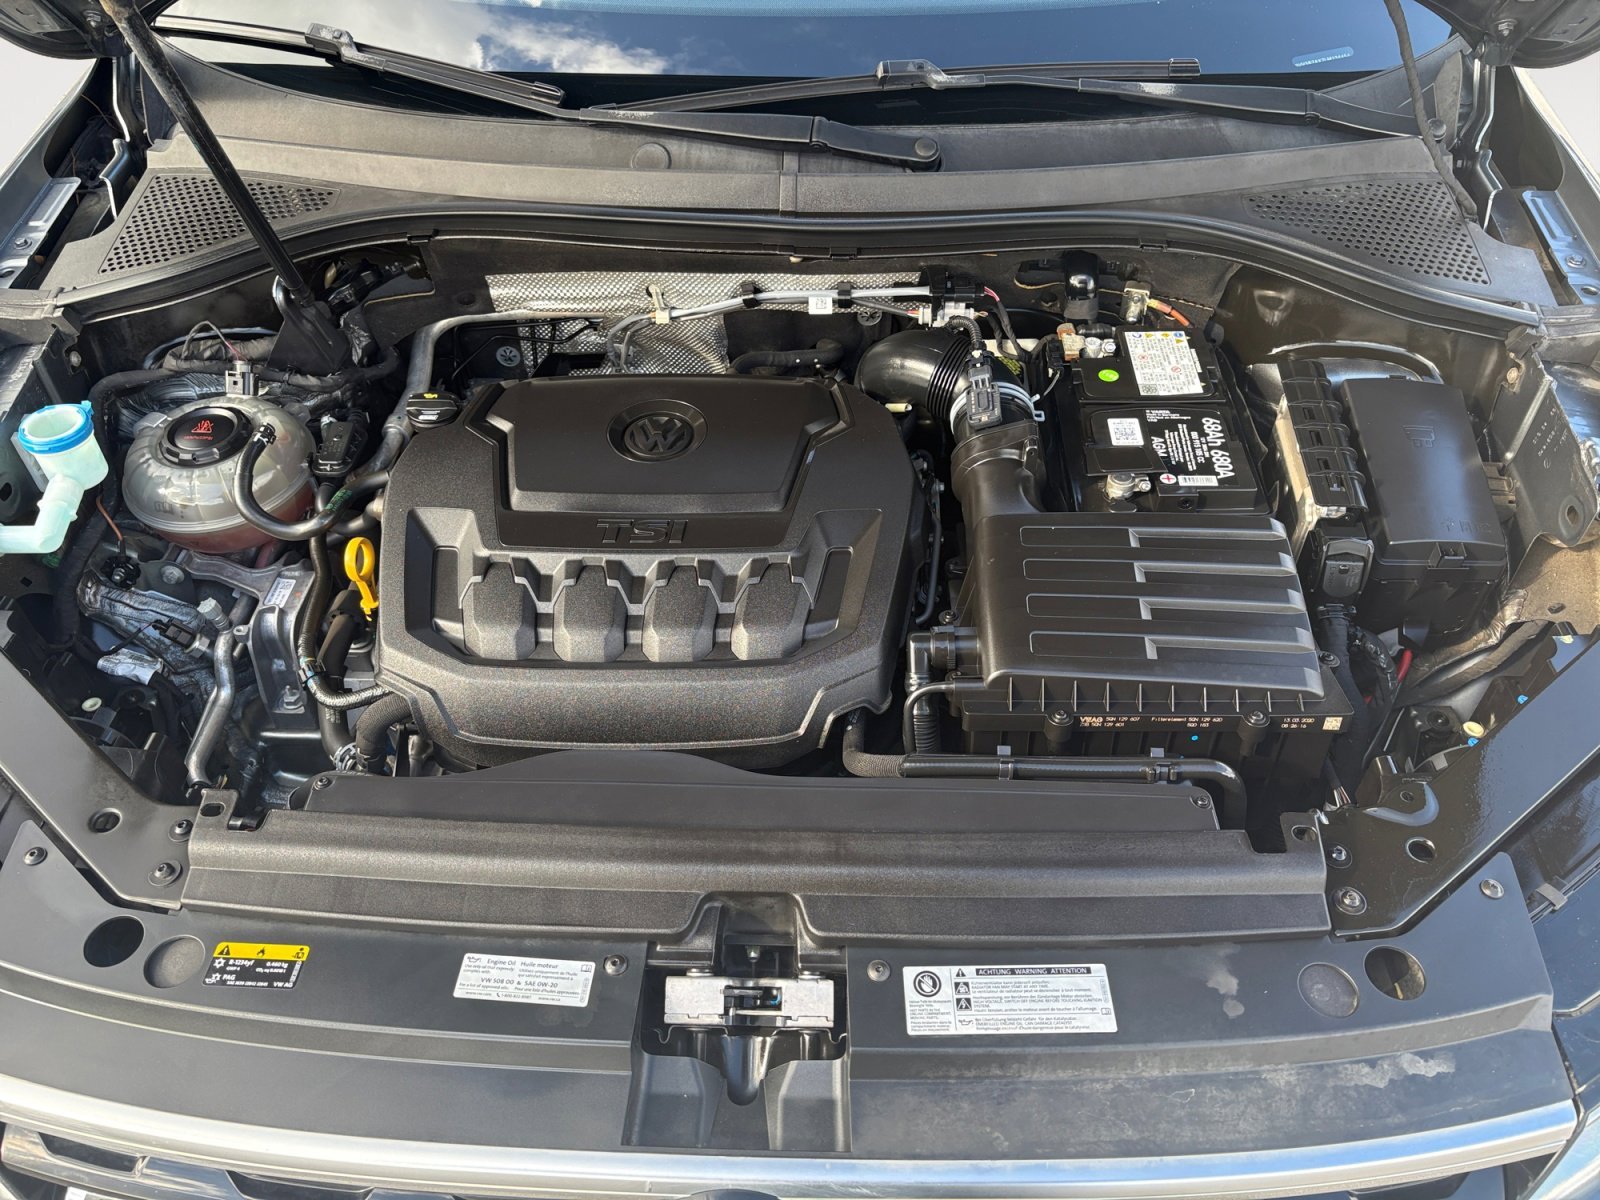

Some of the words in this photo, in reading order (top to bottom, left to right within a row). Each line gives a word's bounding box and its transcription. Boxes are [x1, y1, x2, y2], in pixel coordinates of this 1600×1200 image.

[1201, 417, 1225, 446] 68Ah
[1151, 436, 1168, 457] AGM
[1210, 449, 1236, 479] 680A
[596, 519, 688, 544] TSI
